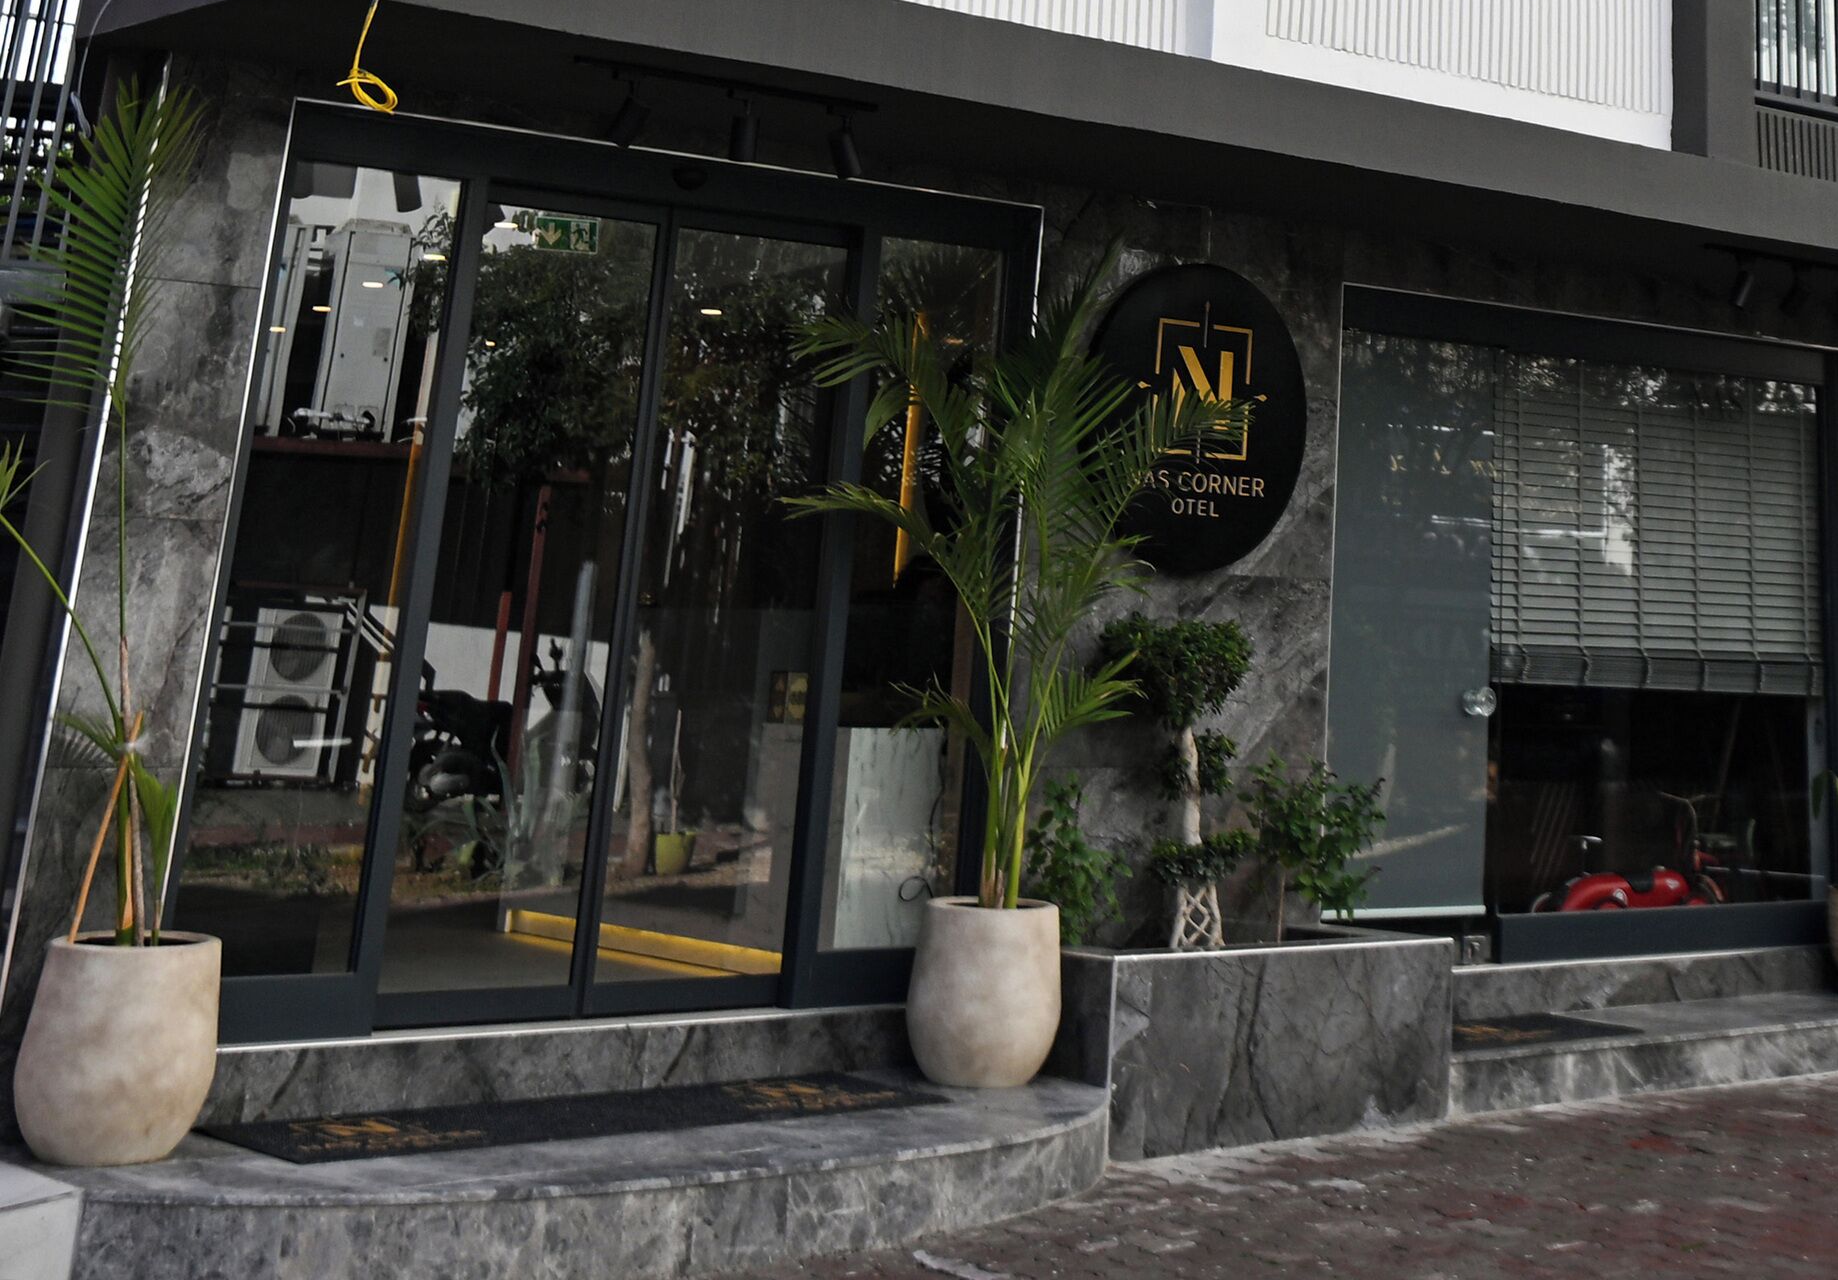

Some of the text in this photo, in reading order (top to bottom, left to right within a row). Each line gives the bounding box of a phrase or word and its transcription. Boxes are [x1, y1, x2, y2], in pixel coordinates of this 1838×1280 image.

[1131, 468, 1266, 498] AS CORNER
[1171, 497, 1220, 518] OTEL
